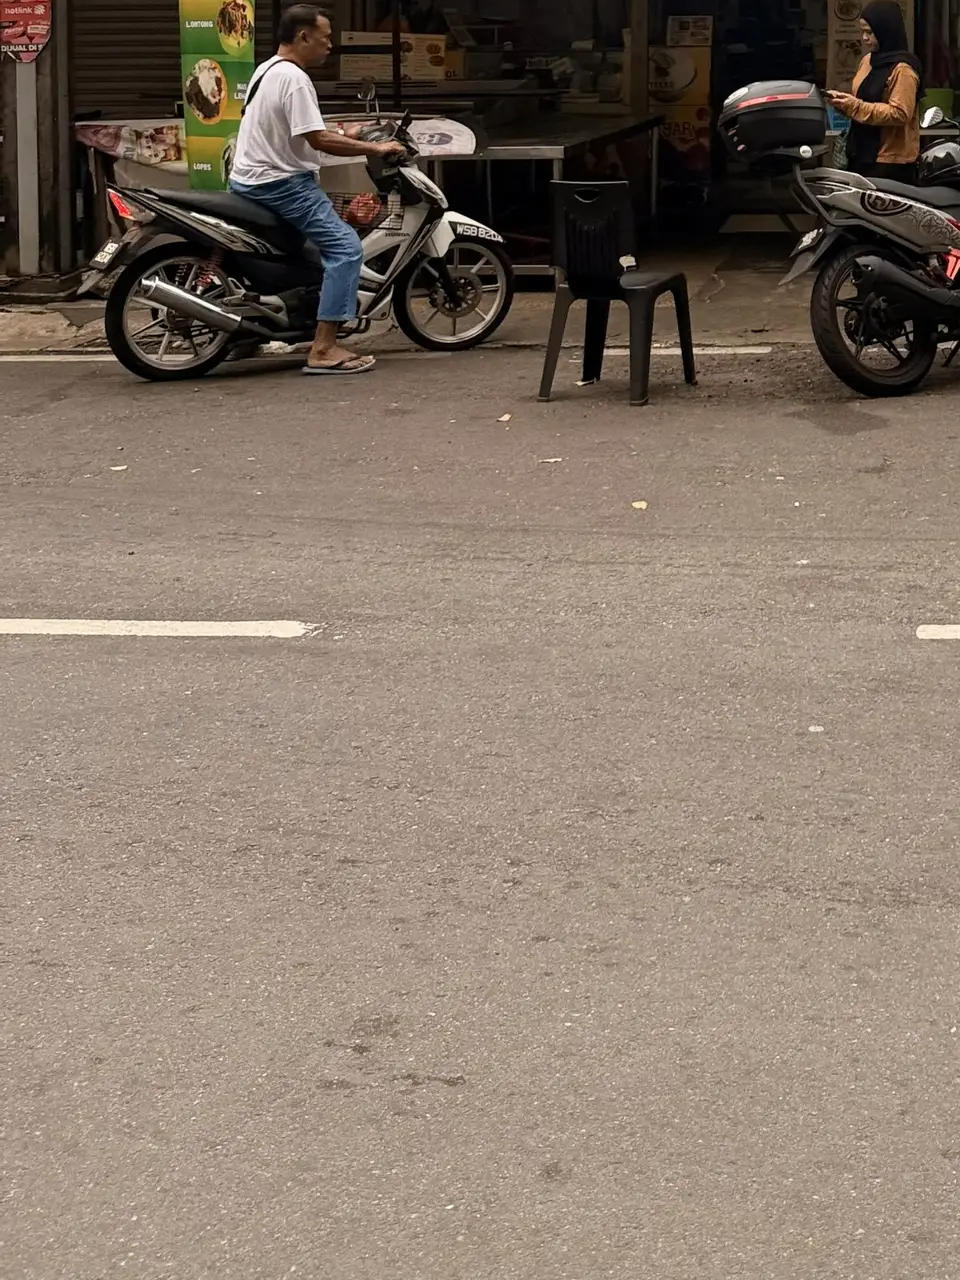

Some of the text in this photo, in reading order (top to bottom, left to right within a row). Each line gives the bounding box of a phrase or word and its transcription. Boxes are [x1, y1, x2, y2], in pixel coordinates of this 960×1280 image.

[5, 6, 33, 14] hotlink
[193, 163, 211, 171] LOPES
[456, 224, 477, 236] WSB
